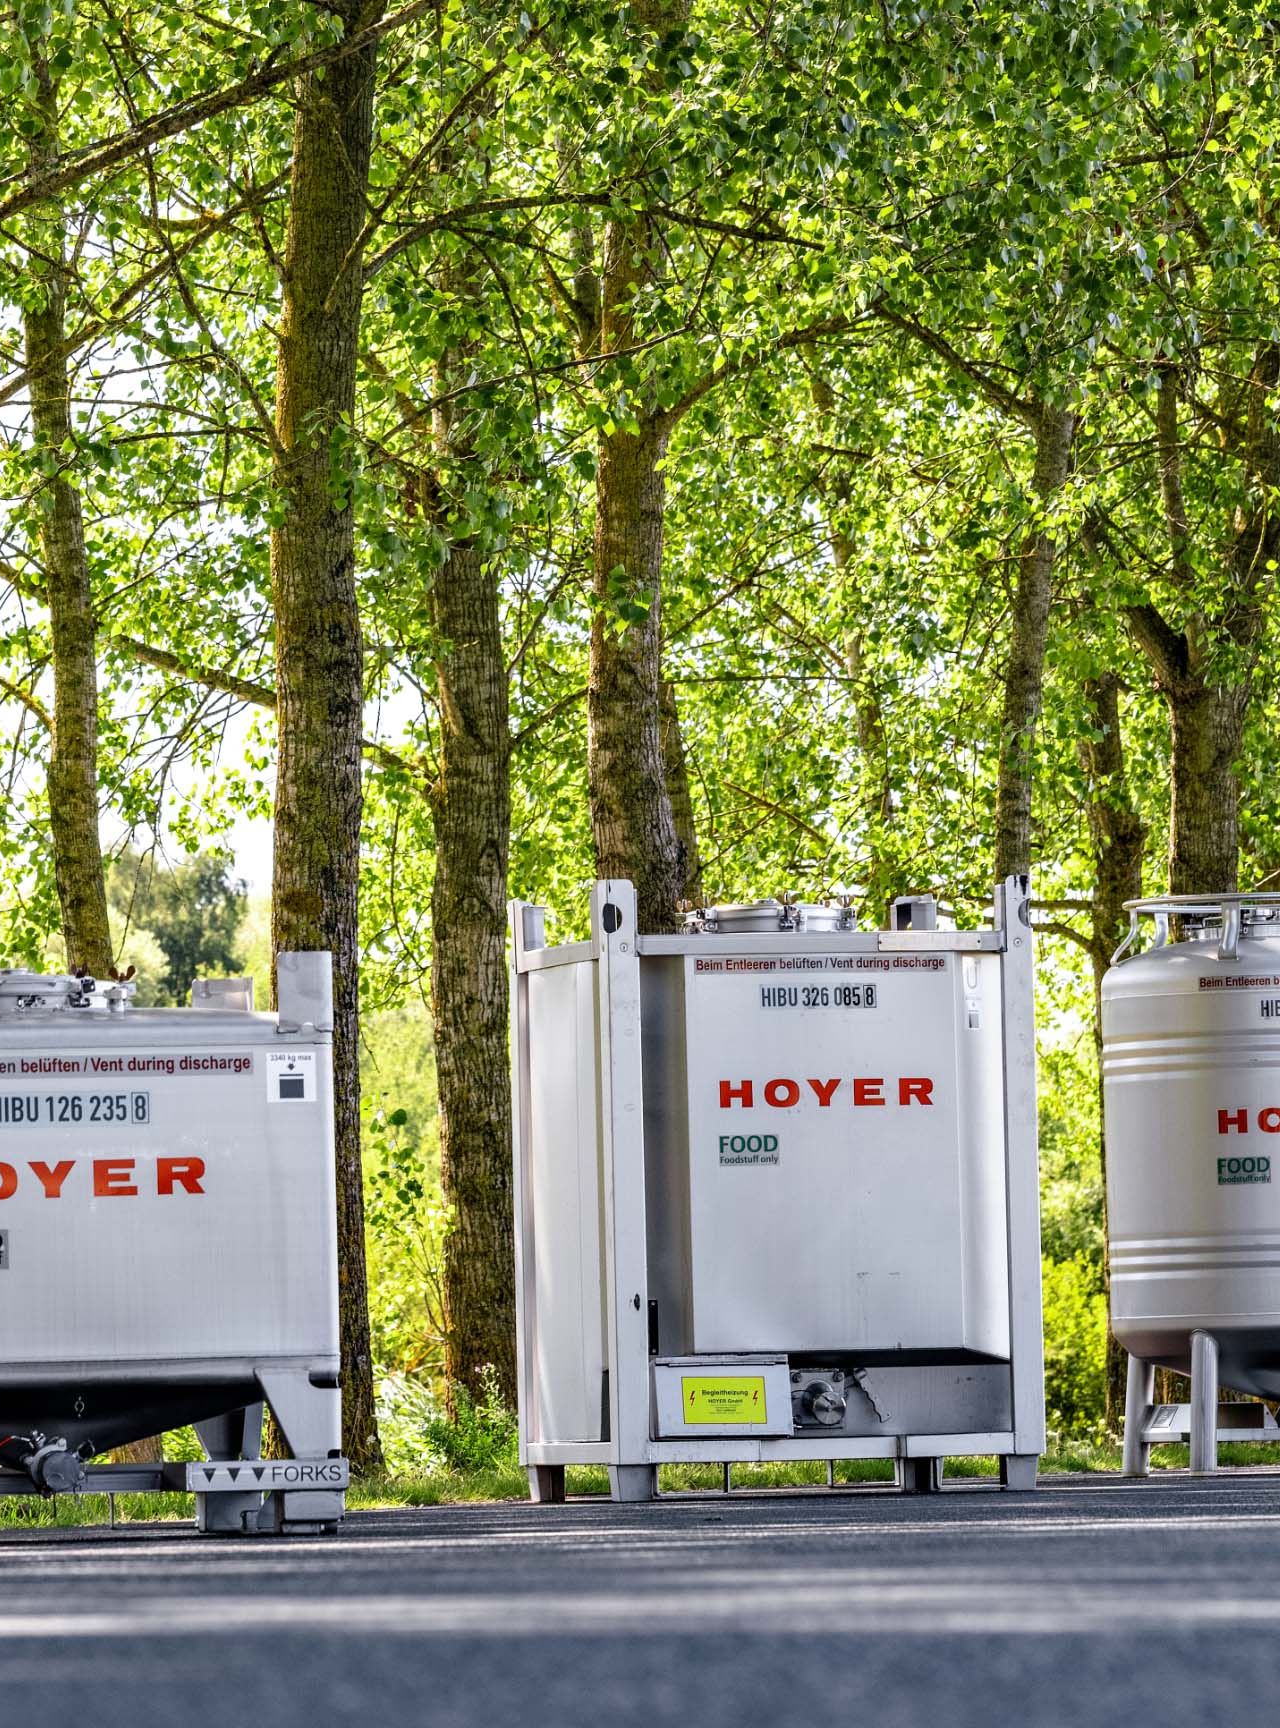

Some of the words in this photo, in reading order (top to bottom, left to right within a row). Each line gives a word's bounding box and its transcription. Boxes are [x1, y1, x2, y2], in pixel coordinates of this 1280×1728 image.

[696, 959, 723, 970] Beim
[726, 959, 776, 970] Entleeren
[780, 958, 822, 969] belüften
[830, 957, 854, 969] Vent
[856, 957, 890, 970] during
[893, 957, 945, 970] discharge
[1200, 977, 1223, 988] Beim
[1225, 976, 1271, 986] Entleeren
[761, 987, 798, 1007] HIBU
[802, 987, 829, 1007] 326
[834, 987, 861, 1007] 085
[865, 986, 874, 1006] 8
[21, 1057, 80, 1073] belüften
[83, 1057, 88, 1073] /
[91, 1057, 123, 1072] Vent
[128, 1056, 175, 1073] during
[179, 1056, 251, 1073] discharge
[288, 1054, 296, 1062] kg
[719, 1078, 934, 1108] HOYER
[45, 1096, 83, 1122] 126
[89, 1095, 127, 1121] 235
[135, 1095, 147, 1121] 8
[719, 1134, 778, 1153] FOOD
[720, 1154, 759, 1165] Foodstuff
[760, 1154, 779, 1165] only
[1217, 1156, 1270, 1174] FOOD
[272, 1465, 342, 1482] FORKS
